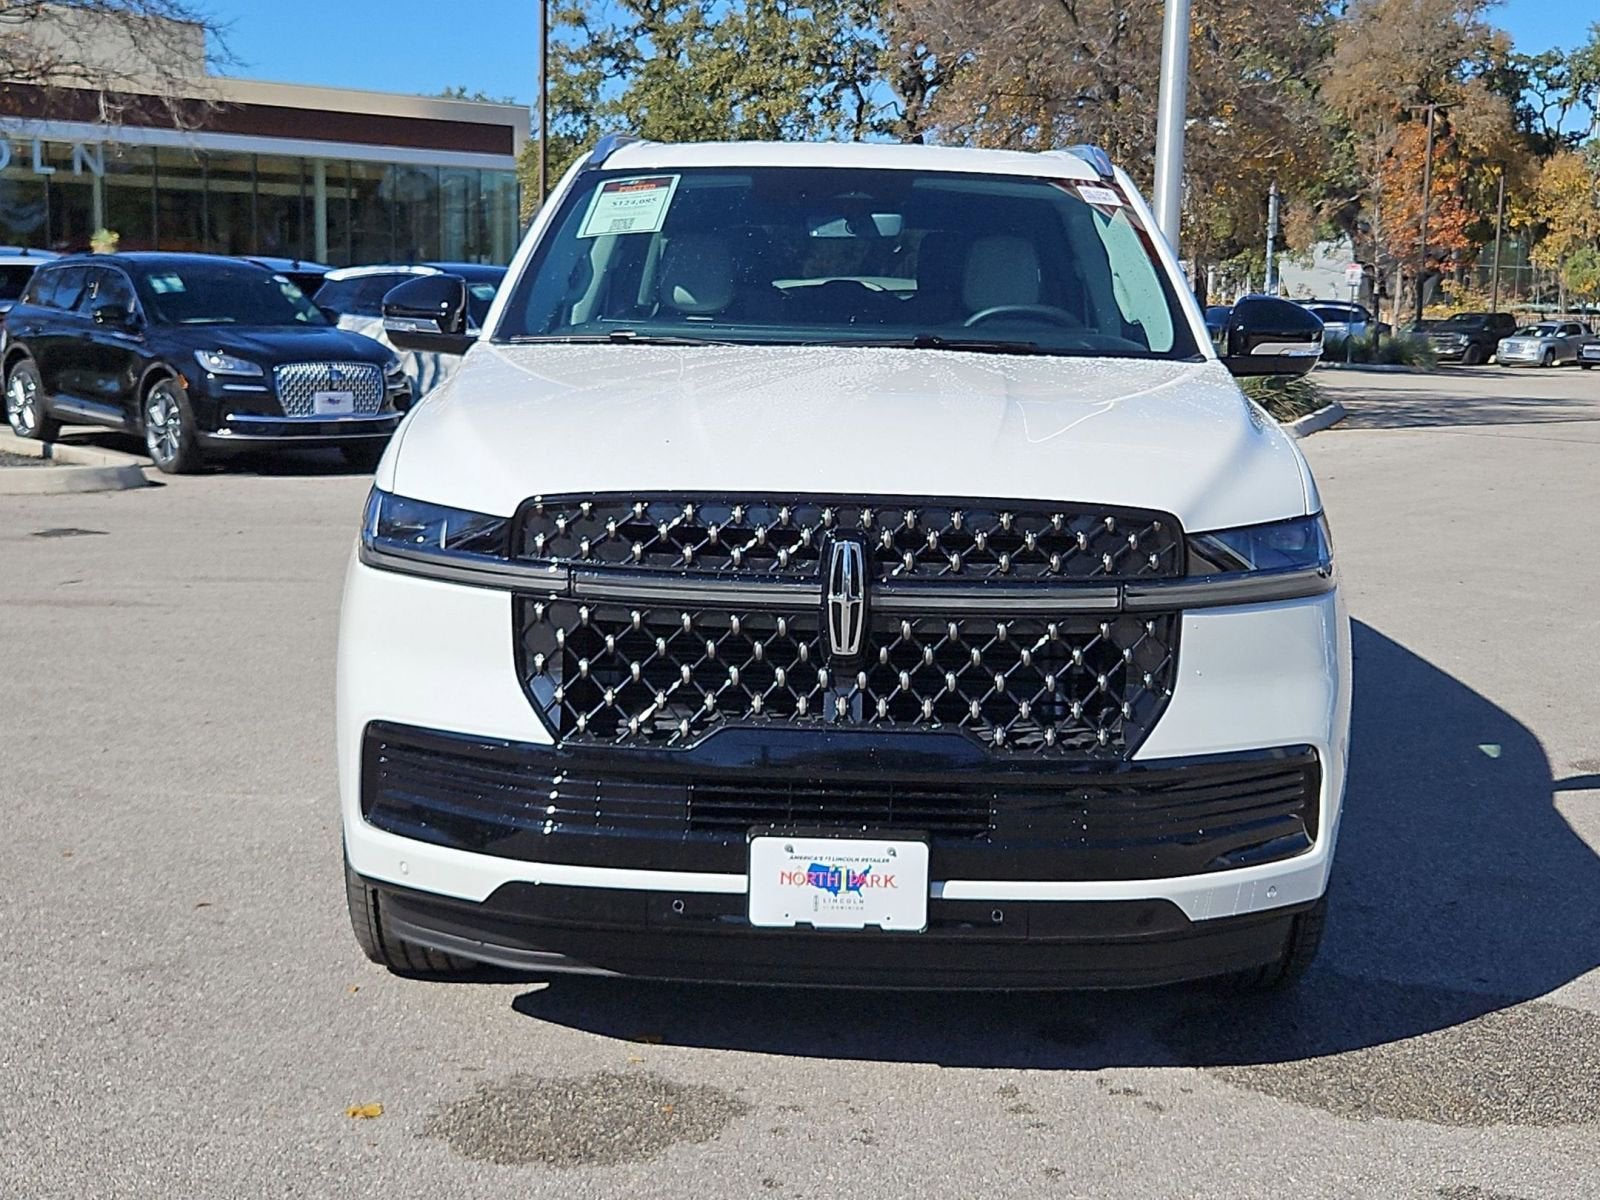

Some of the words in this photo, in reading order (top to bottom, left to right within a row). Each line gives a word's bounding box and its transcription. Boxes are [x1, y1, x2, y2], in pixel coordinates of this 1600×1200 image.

[780, 870, 840, 888] NORTH
[848, 870, 898, 889] PARK
[823, 897, 865, 905] LINCOLN
